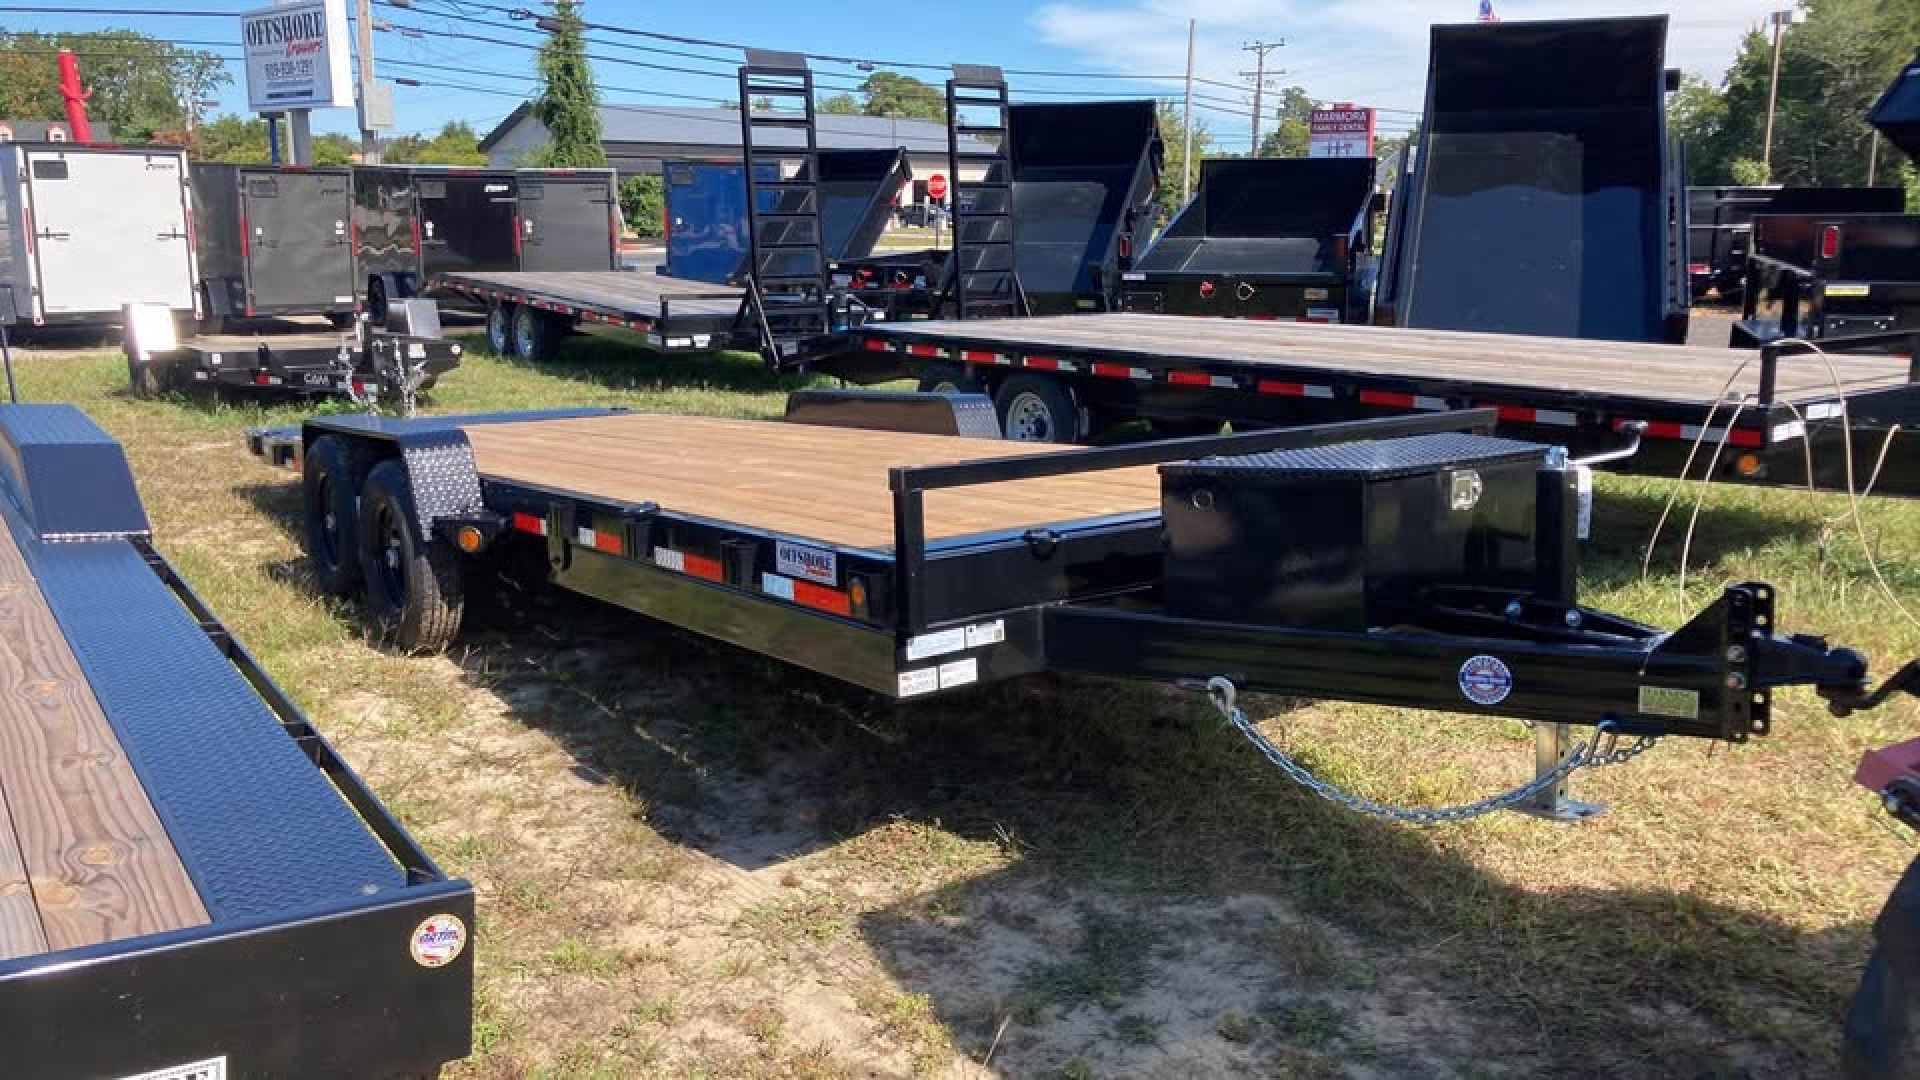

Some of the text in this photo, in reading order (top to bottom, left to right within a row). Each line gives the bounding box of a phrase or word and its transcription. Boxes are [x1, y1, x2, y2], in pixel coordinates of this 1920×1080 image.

[247, 11, 323, 46] OFFSHORE
[1313, 111, 1367, 122] MARMORA
[779, 548, 833, 571] OFFSHORE
